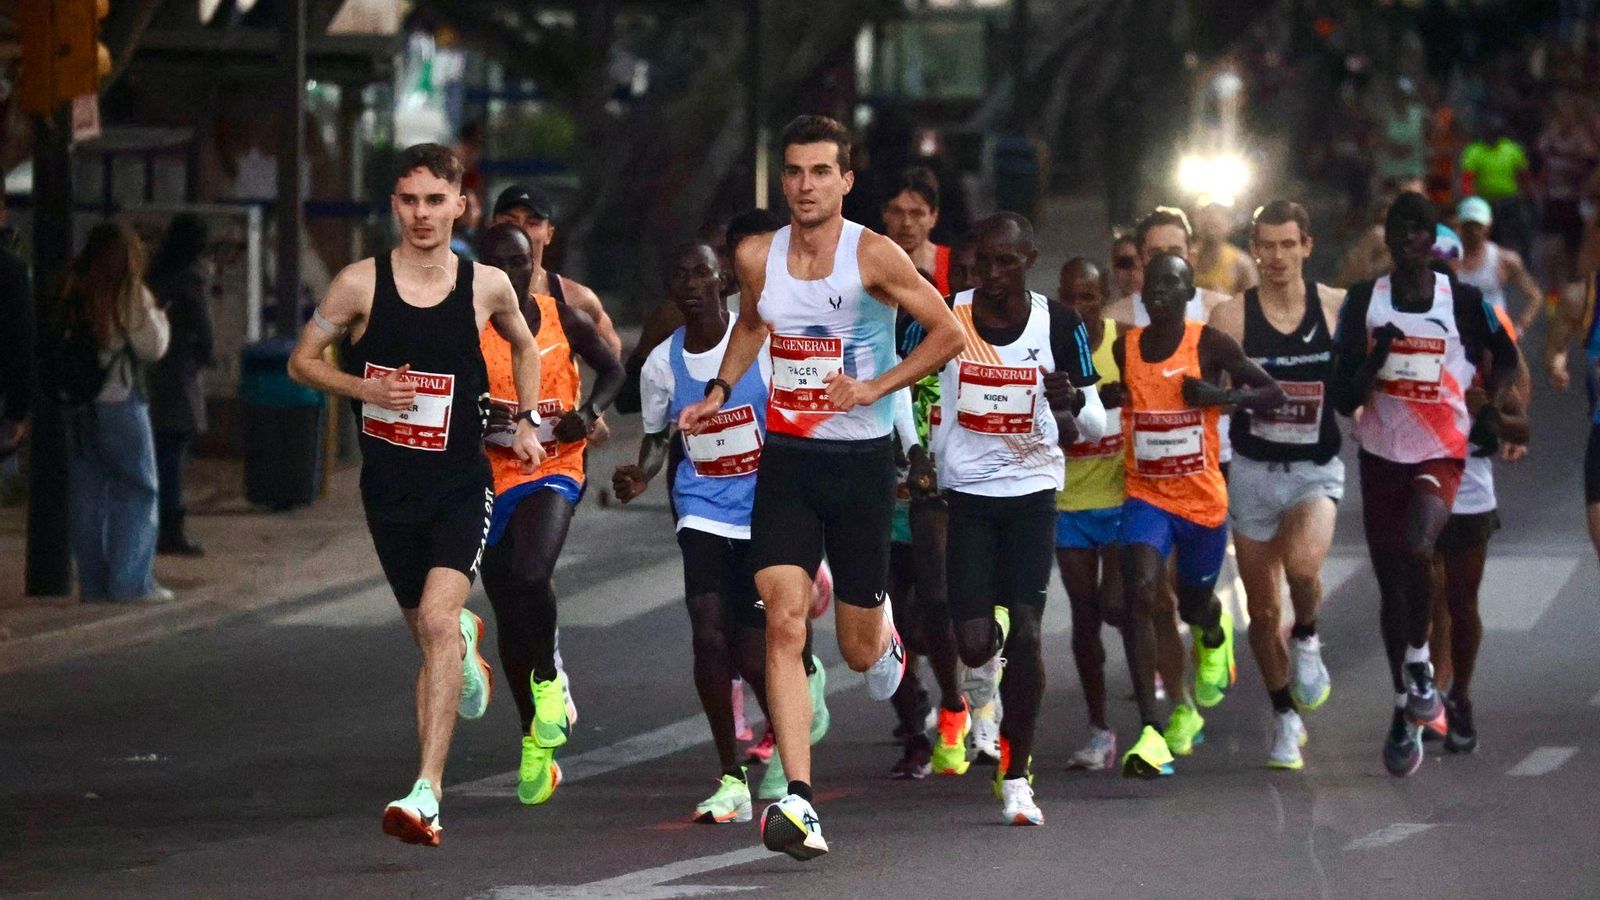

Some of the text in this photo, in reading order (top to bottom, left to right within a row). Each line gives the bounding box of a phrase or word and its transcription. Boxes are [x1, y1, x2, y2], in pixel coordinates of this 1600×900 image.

[782, 339, 837, 353] GENERALI
[979, 367, 1034, 381] GENERALI
[983, 393, 1009, 402] KIGEN
[399, 413, 409, 421] 40
[715, 439, 726, 447] 37
